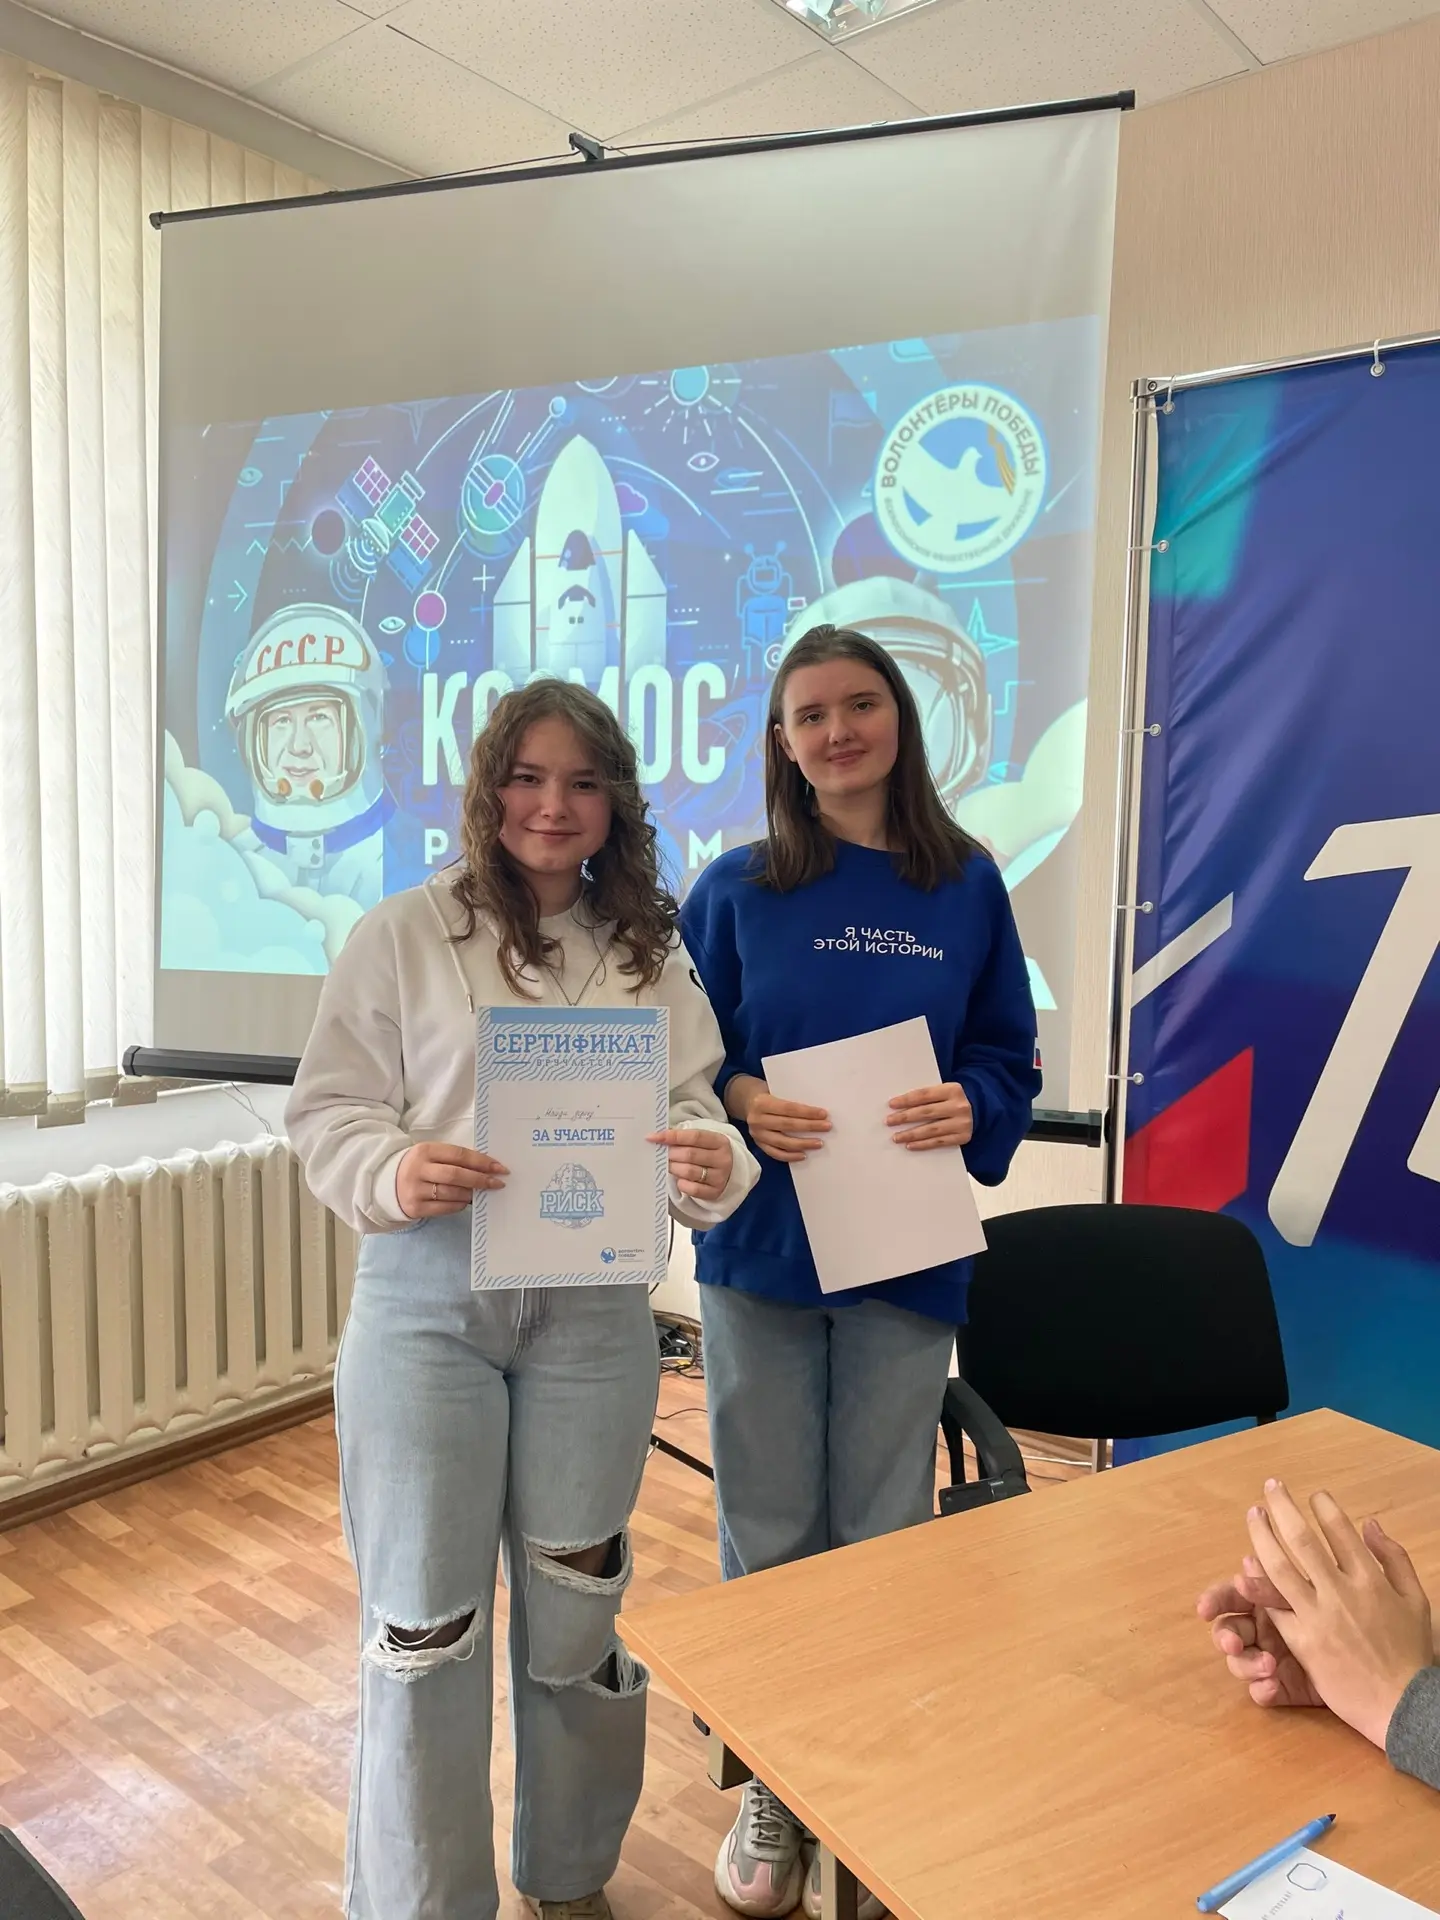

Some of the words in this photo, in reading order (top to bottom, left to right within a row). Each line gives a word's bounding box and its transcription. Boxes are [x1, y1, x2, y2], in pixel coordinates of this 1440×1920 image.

[881, 391, 979, 488] ВОЛОНТЁРЫ
[982, 396, 1041, 477] ПОБЕДЫ
[844, 926, 856, 938] Я
[861, 927, 916, 943] ЧАСТЬ
[813, 937, 860, 952] ЭТОЙ
[865, 941, 943, 961] ИСТОРИИ
[493, 1033, 656, 1054] СЕРТИФИКАТ
[532, 1129, 550, 1141] ЗА
[554, 1128, 615, 1141] УЧАСТИЕ
[542, 1191, 603, 1213] РИСК
